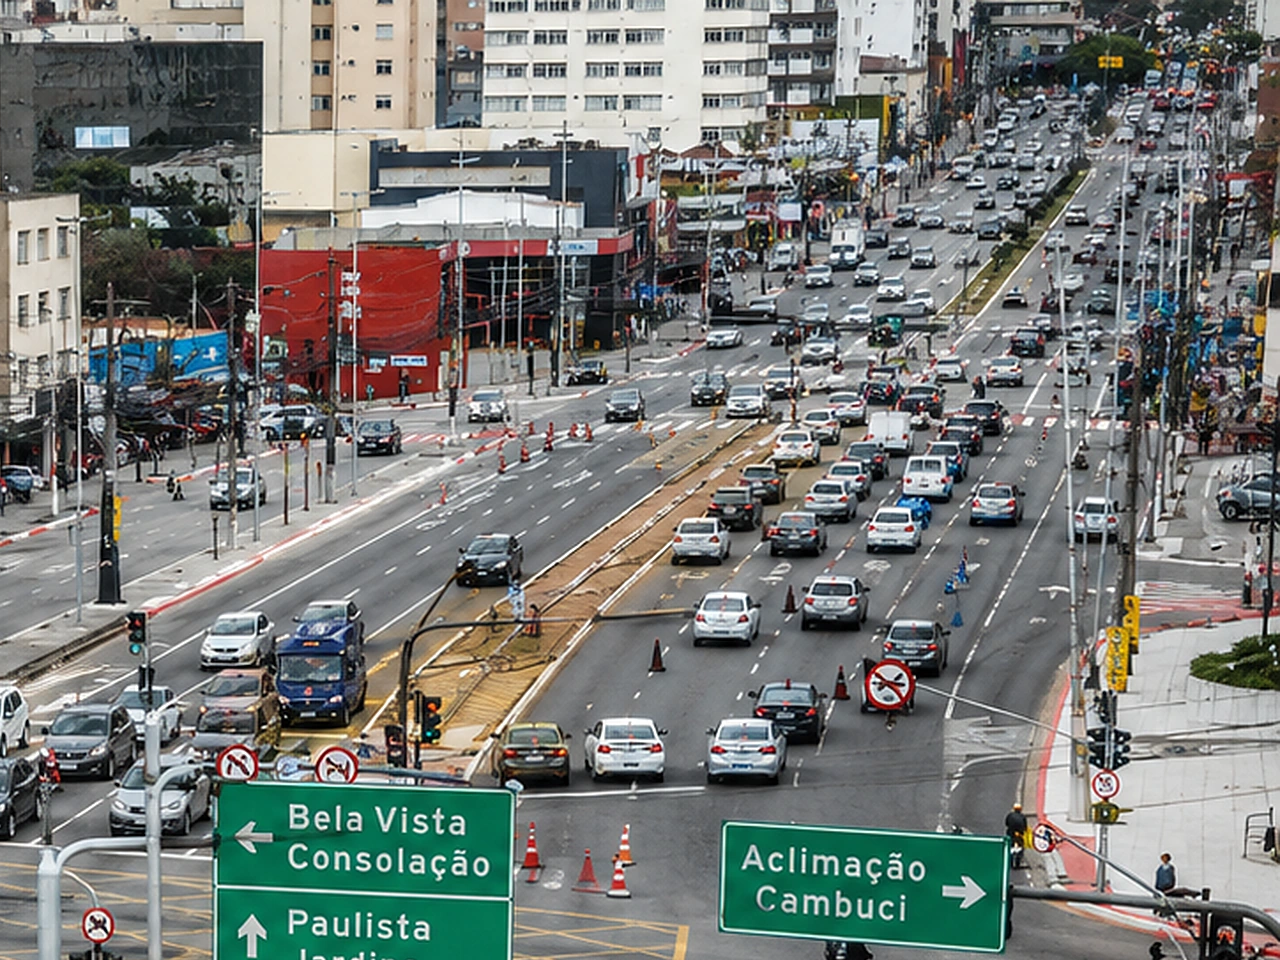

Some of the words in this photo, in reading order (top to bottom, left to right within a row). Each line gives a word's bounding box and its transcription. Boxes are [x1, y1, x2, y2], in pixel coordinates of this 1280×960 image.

[289, 803, 363, 832] Bela
[374, 805, 466, 836] Vista
[287, 843, 490, 882] Consolação
[741, 844, 926, 885] Aclimação
[756, 885, 906, 922] Cambuci
[288, 908, 430, 941] Paulista
